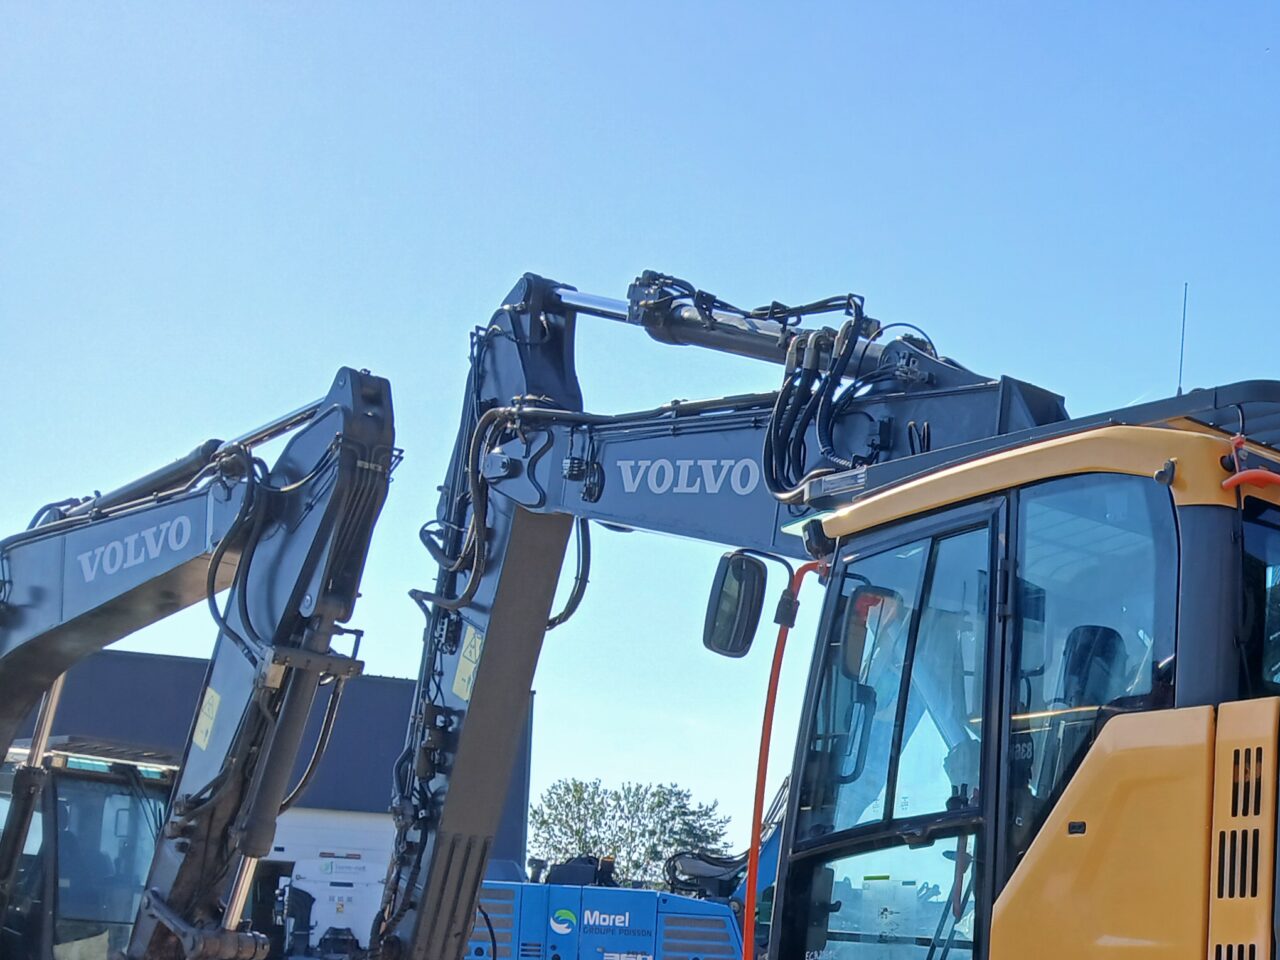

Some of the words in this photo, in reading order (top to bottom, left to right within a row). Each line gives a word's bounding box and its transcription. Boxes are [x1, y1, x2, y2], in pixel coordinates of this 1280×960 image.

[616, 458, 760, 496] VOLVO
[77, 515, 192, 583] VOLVO
[583, 910, 630, 928] Morel
